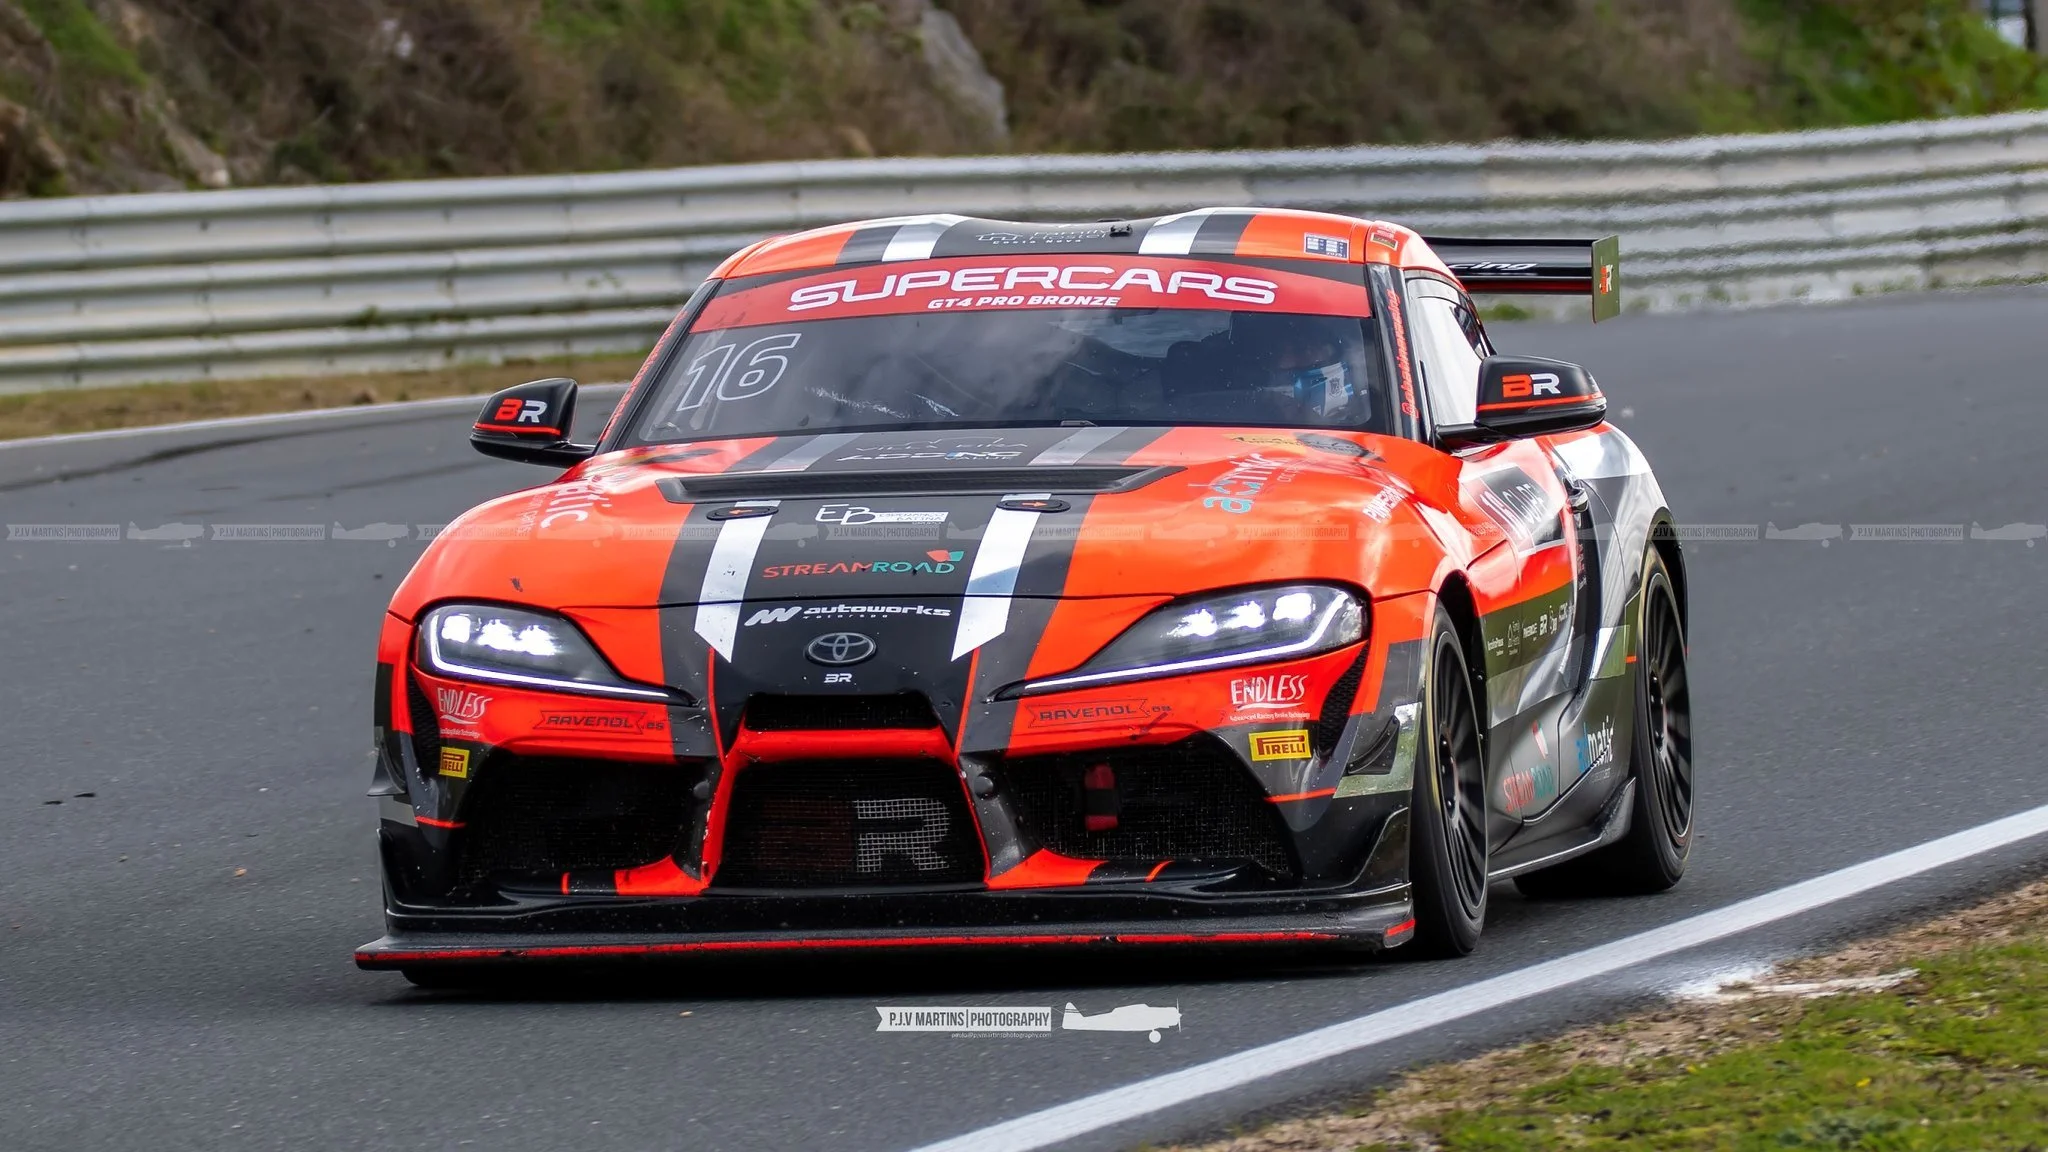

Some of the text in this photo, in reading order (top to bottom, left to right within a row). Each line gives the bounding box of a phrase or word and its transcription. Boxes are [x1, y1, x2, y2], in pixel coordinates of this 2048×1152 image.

[1448, 260, 1538, 271] cing
[787, 265, 1278, 311] SUPERCARS
[928, 294, 1121, 309] GT4 PRO BRONZE
[675, 333, 802, 412] 16
[1502, 373, 1561, 397] BR
[494, 398, 548, 423] BR
[836, 450, 1023, 462] ADDING
[815, 503, 878, 525] EB
[763, 561, 956, 579] STREAMROAD
[803, 603, 951, 617] autoworks
[824, 673, 853, 683] BR
[1230, 674, 1309, 705] ENDLESS
[437, 687, 494, 719] ENDLESS
[546, 715, 633, 728] RAVENOL
[1040, 705, 1137, 721] RAVENOL
[1256, 735, 1306, 756] PIRELLI
